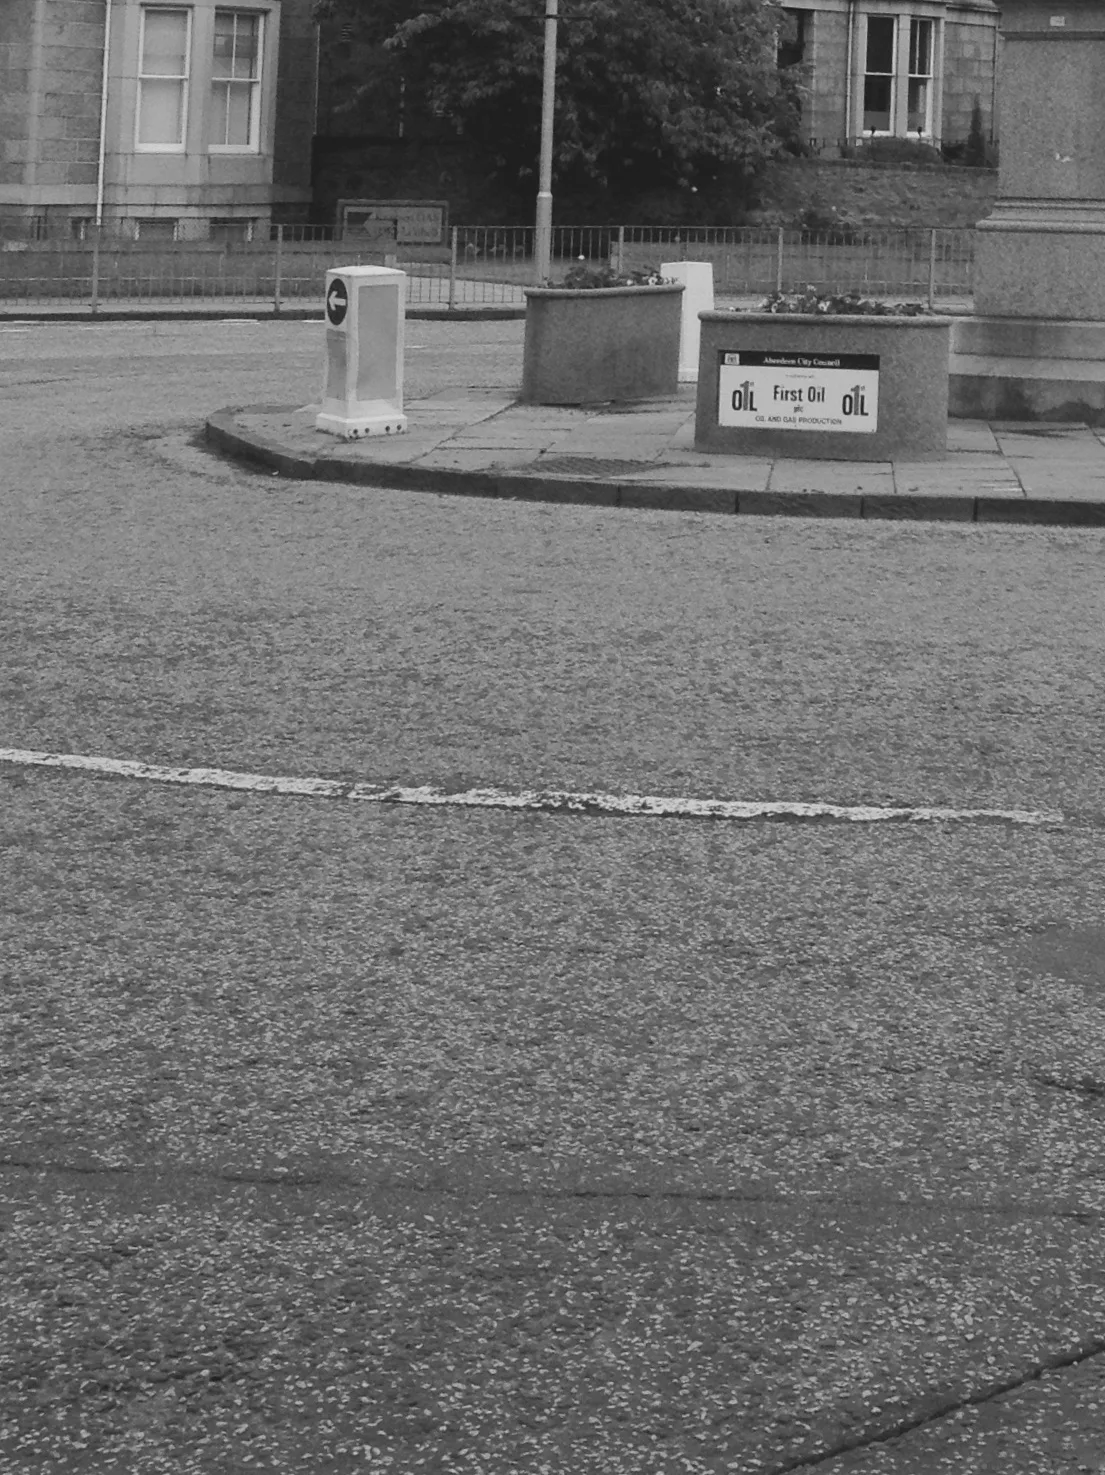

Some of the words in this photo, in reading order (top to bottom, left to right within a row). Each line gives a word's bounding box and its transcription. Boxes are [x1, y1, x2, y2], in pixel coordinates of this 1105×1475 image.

[763, 357, 796, 365] Aberdeen
[797, 358, 812, 367] City
[814, 358, 841, 367] Council
[773, 385, 803, 402] First
[807, 386, 825, 403] Oil
[799, 417, 842, 425] PRODUCTION
